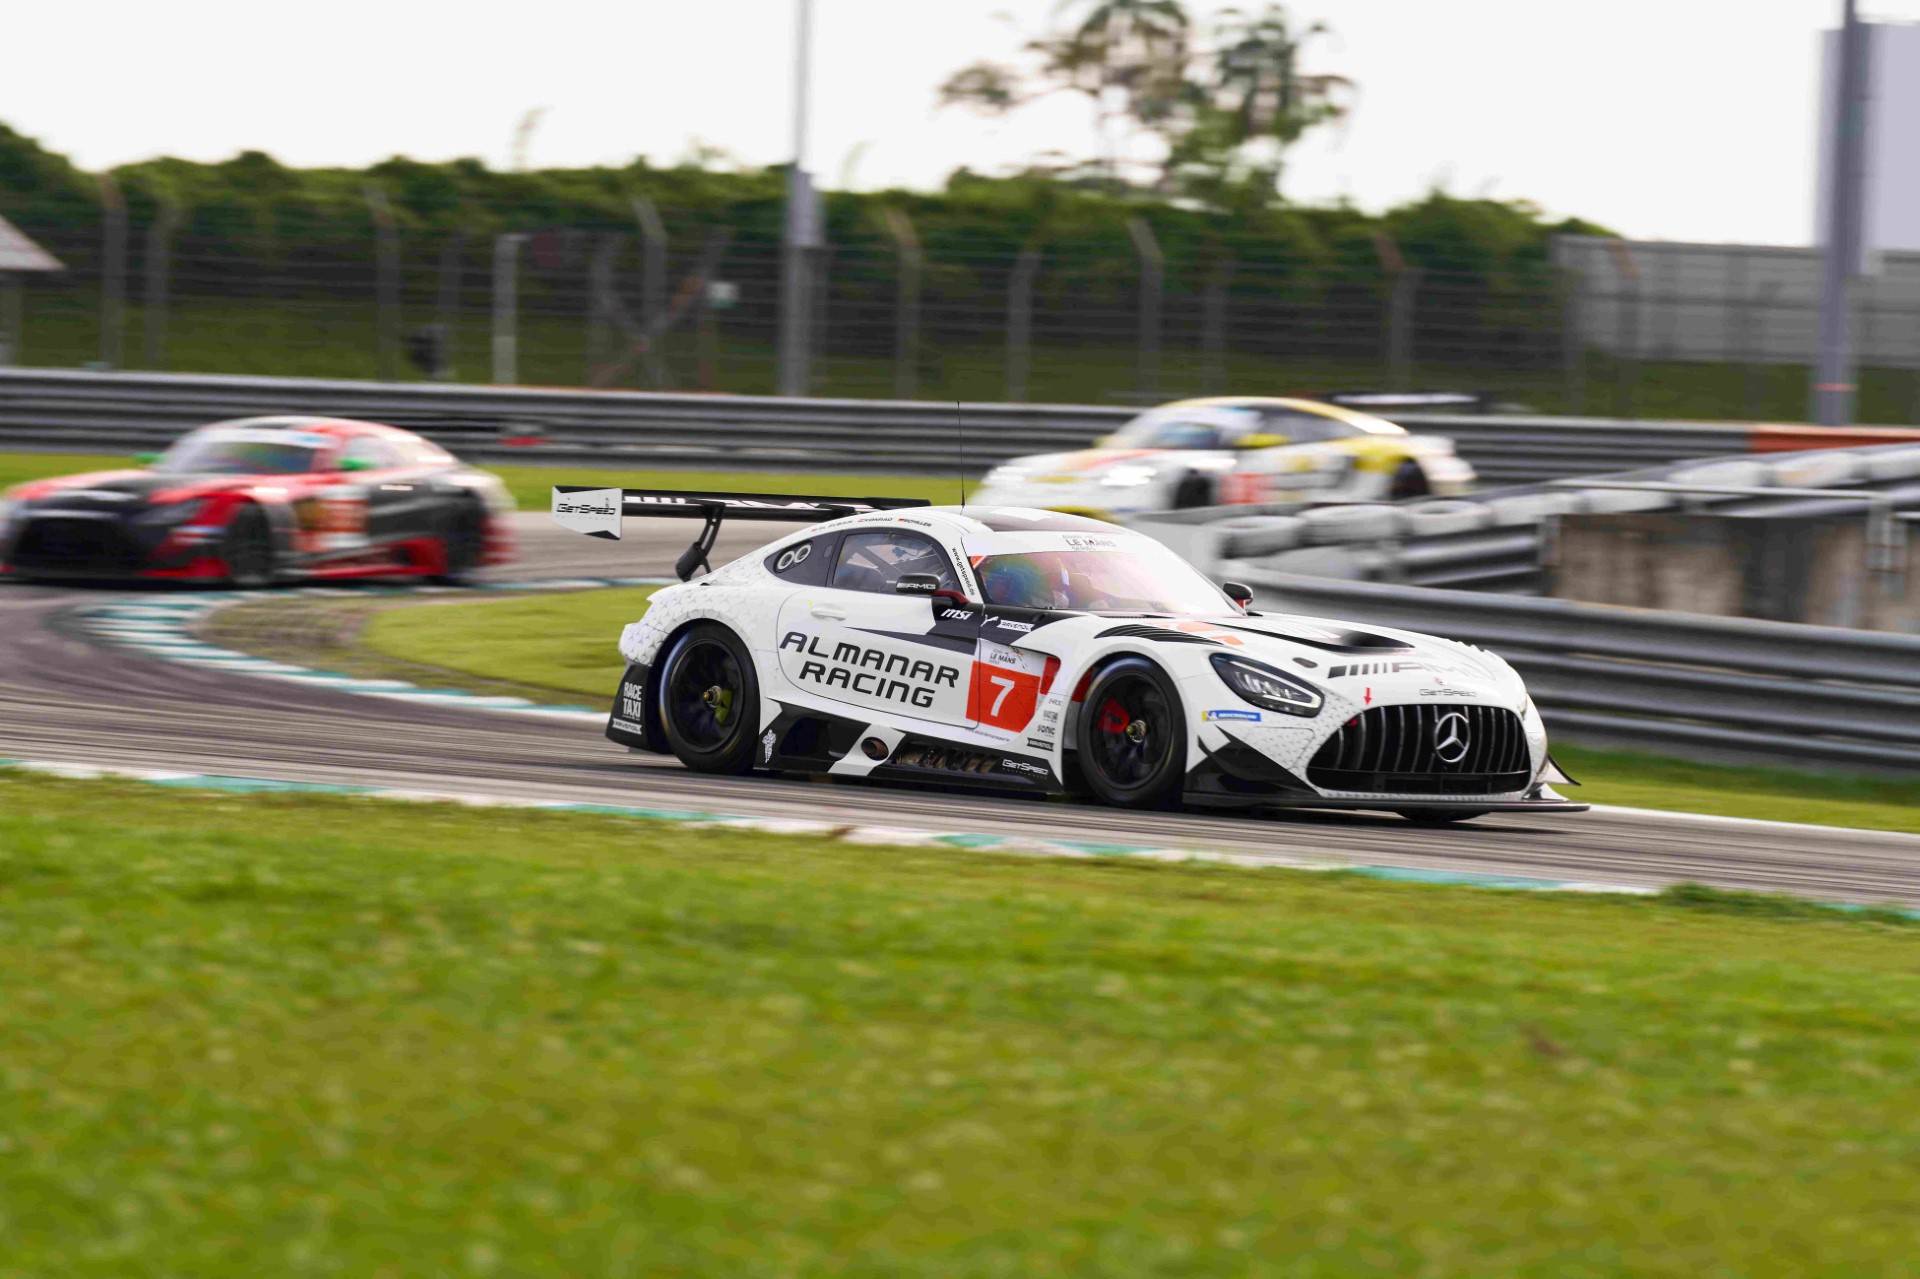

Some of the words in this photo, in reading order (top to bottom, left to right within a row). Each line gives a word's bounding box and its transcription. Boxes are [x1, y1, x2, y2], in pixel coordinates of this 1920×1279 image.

[779, 631, 960, 688] ALMANAR
[998, 655, 1016, 664] MANS
[624, 682, 642, 700] RACE
[798, 660, 936, 708] RACING
[990, 675, 1015, 717] 7
[623, 697, 642, 717] TAXI
